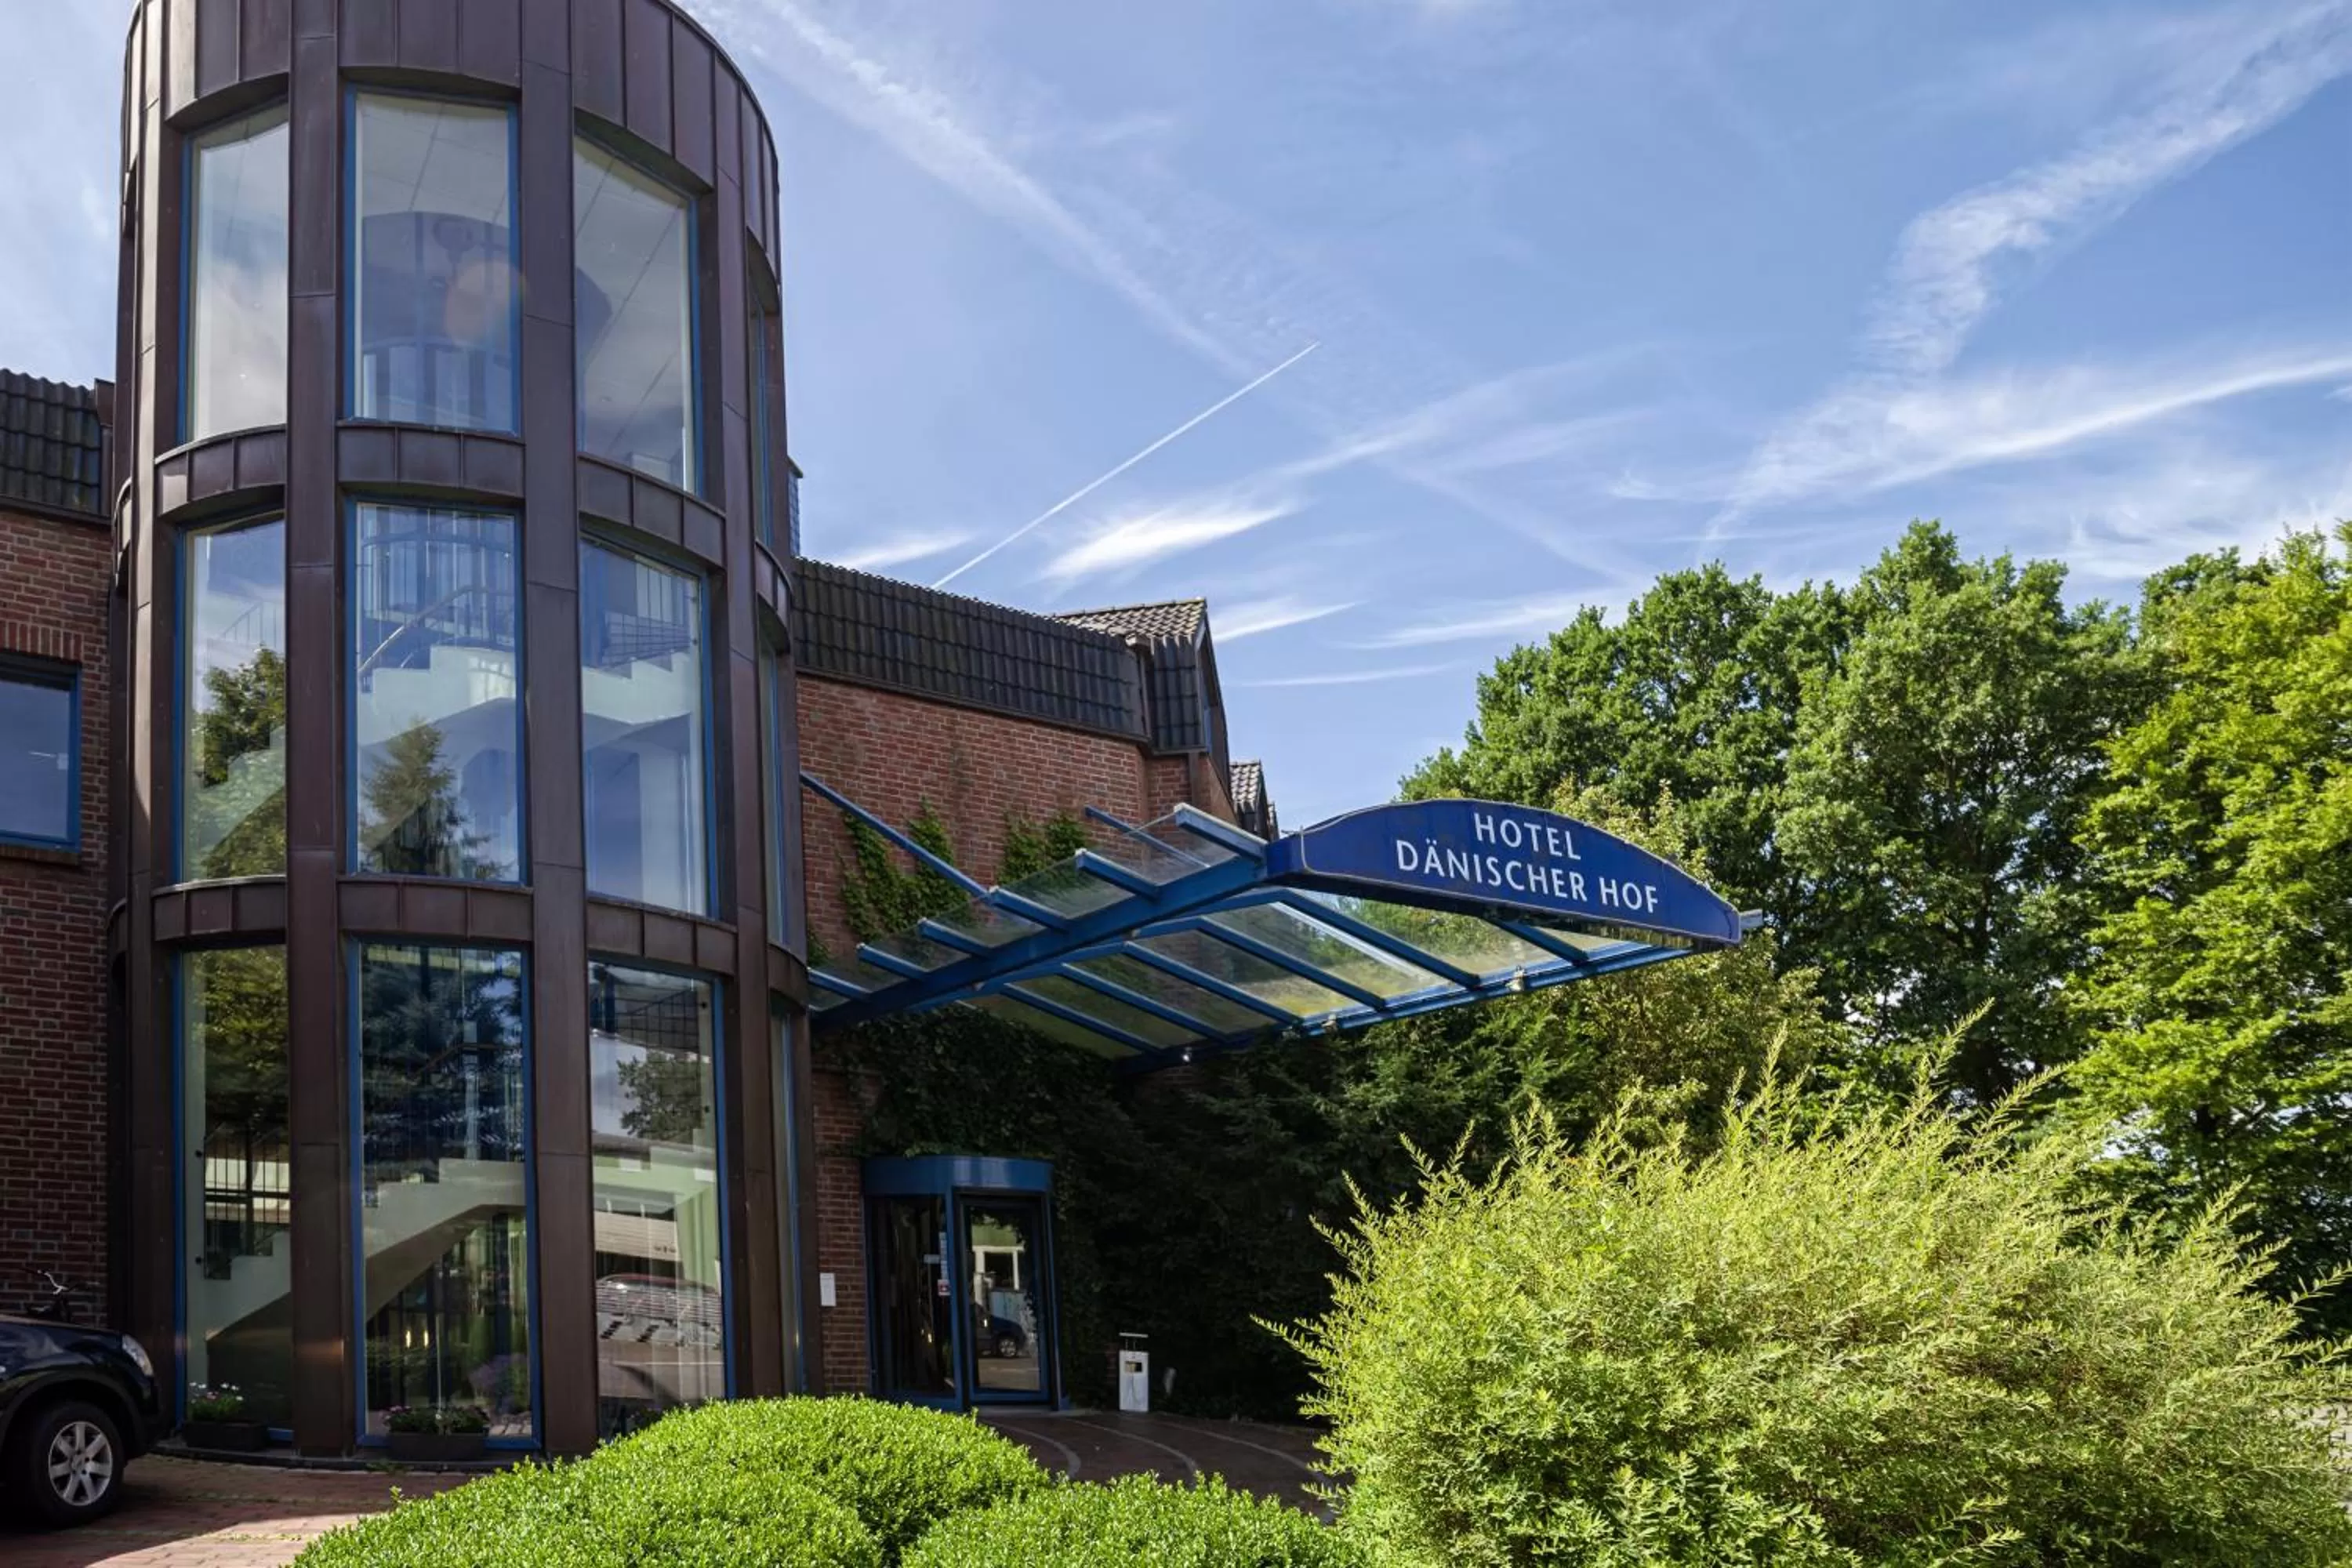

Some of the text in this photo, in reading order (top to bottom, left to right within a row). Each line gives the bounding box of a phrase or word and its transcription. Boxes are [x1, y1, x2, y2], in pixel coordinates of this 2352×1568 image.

[1473, 812, 1581, 861] HOTEL
[1396, 838, 1660, 914] DÄNISCHER HOF
